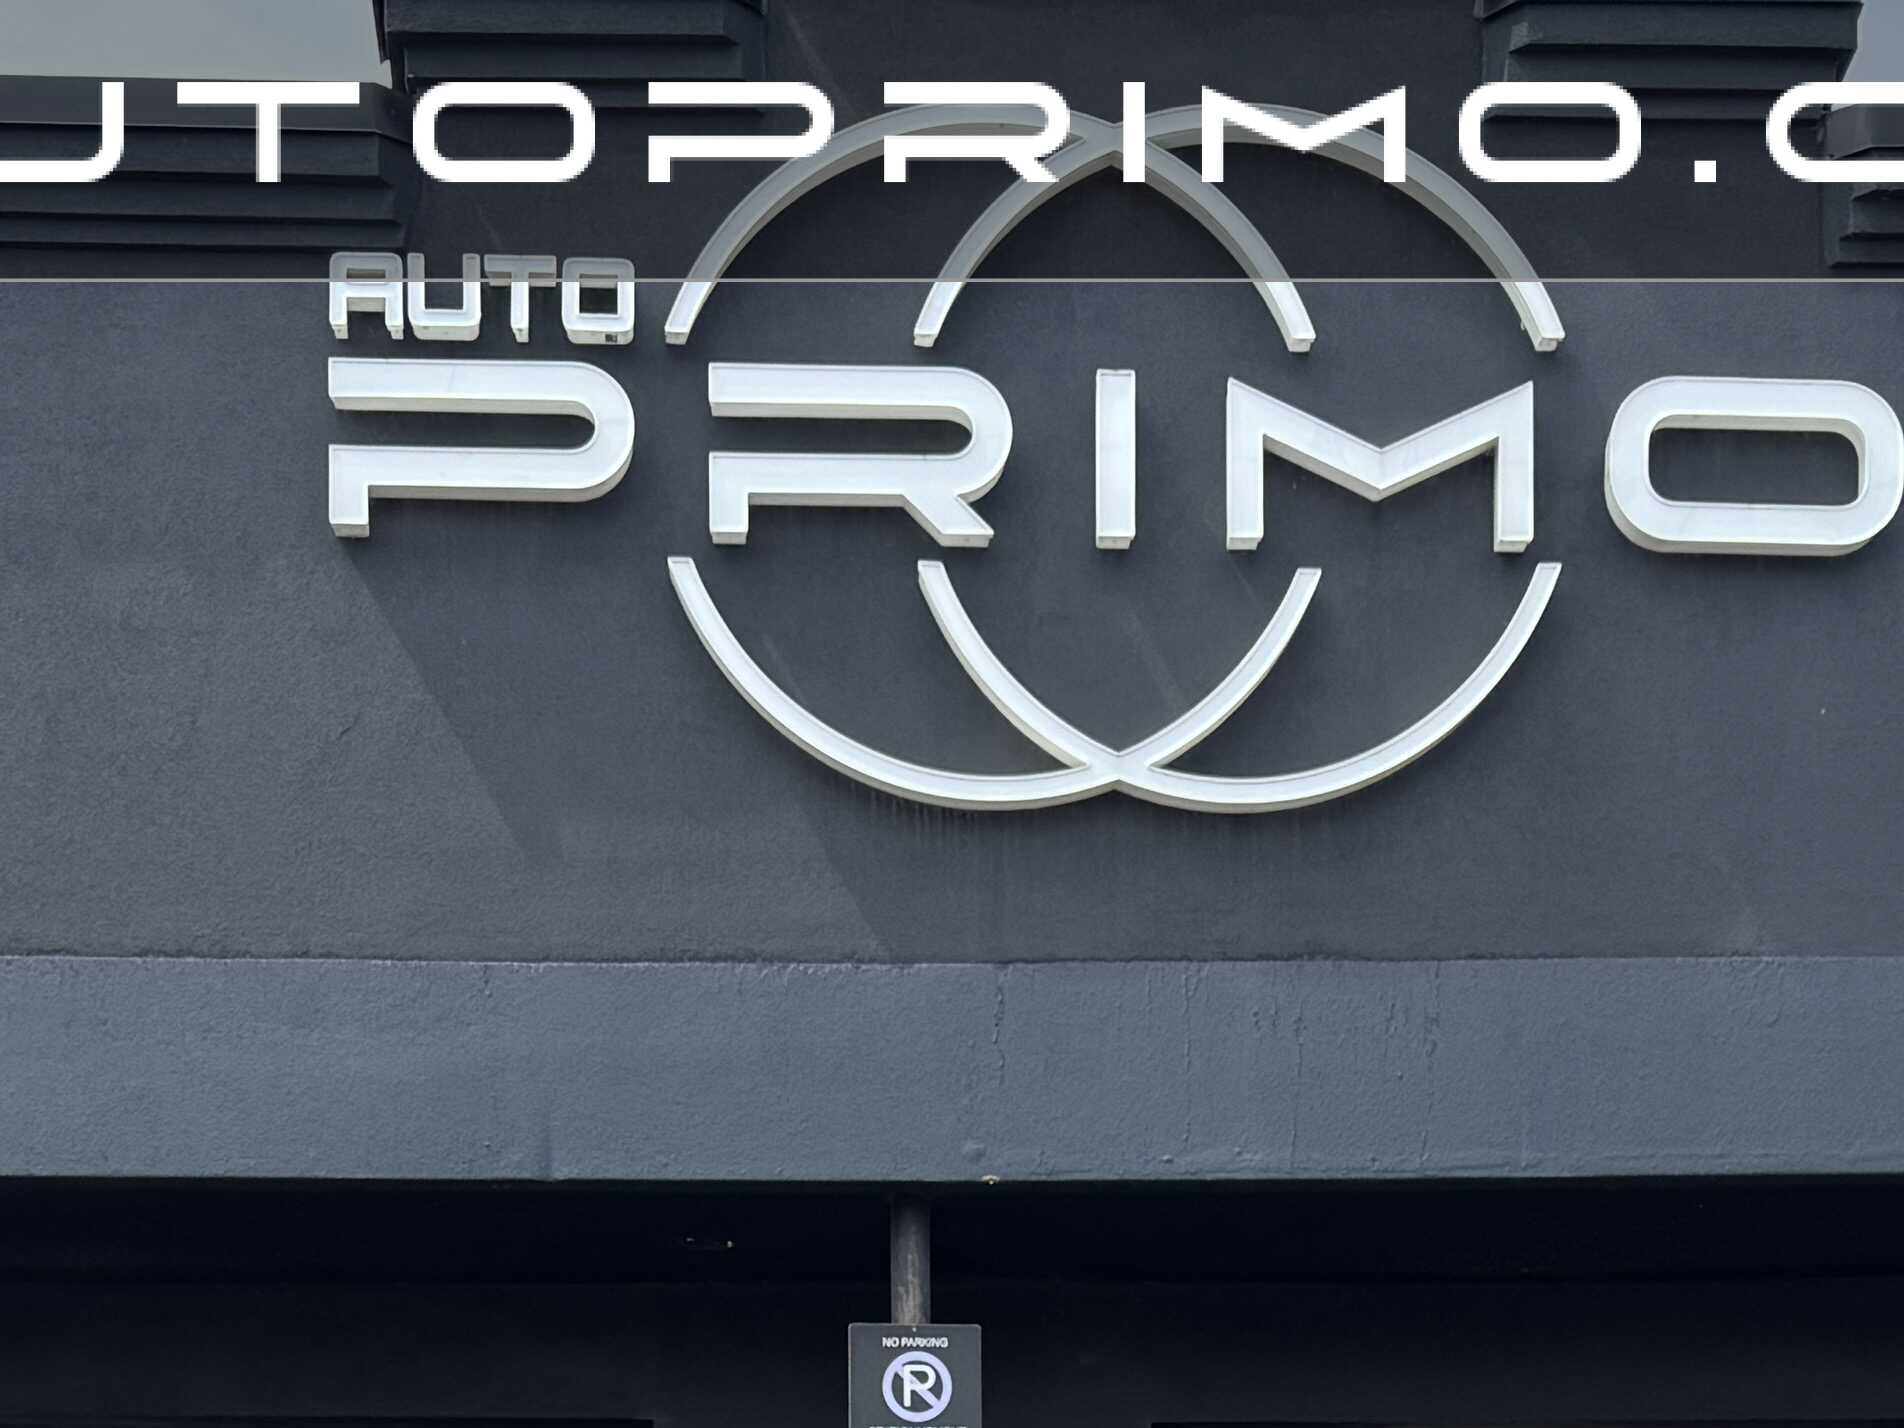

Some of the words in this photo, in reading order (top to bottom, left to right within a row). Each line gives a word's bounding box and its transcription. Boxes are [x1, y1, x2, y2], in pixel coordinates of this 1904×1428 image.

[329, 251, 636, 345] AUTO
[882, 1337, 899, 1347] NO
[901, 1337, 949, 1348] PARKING
